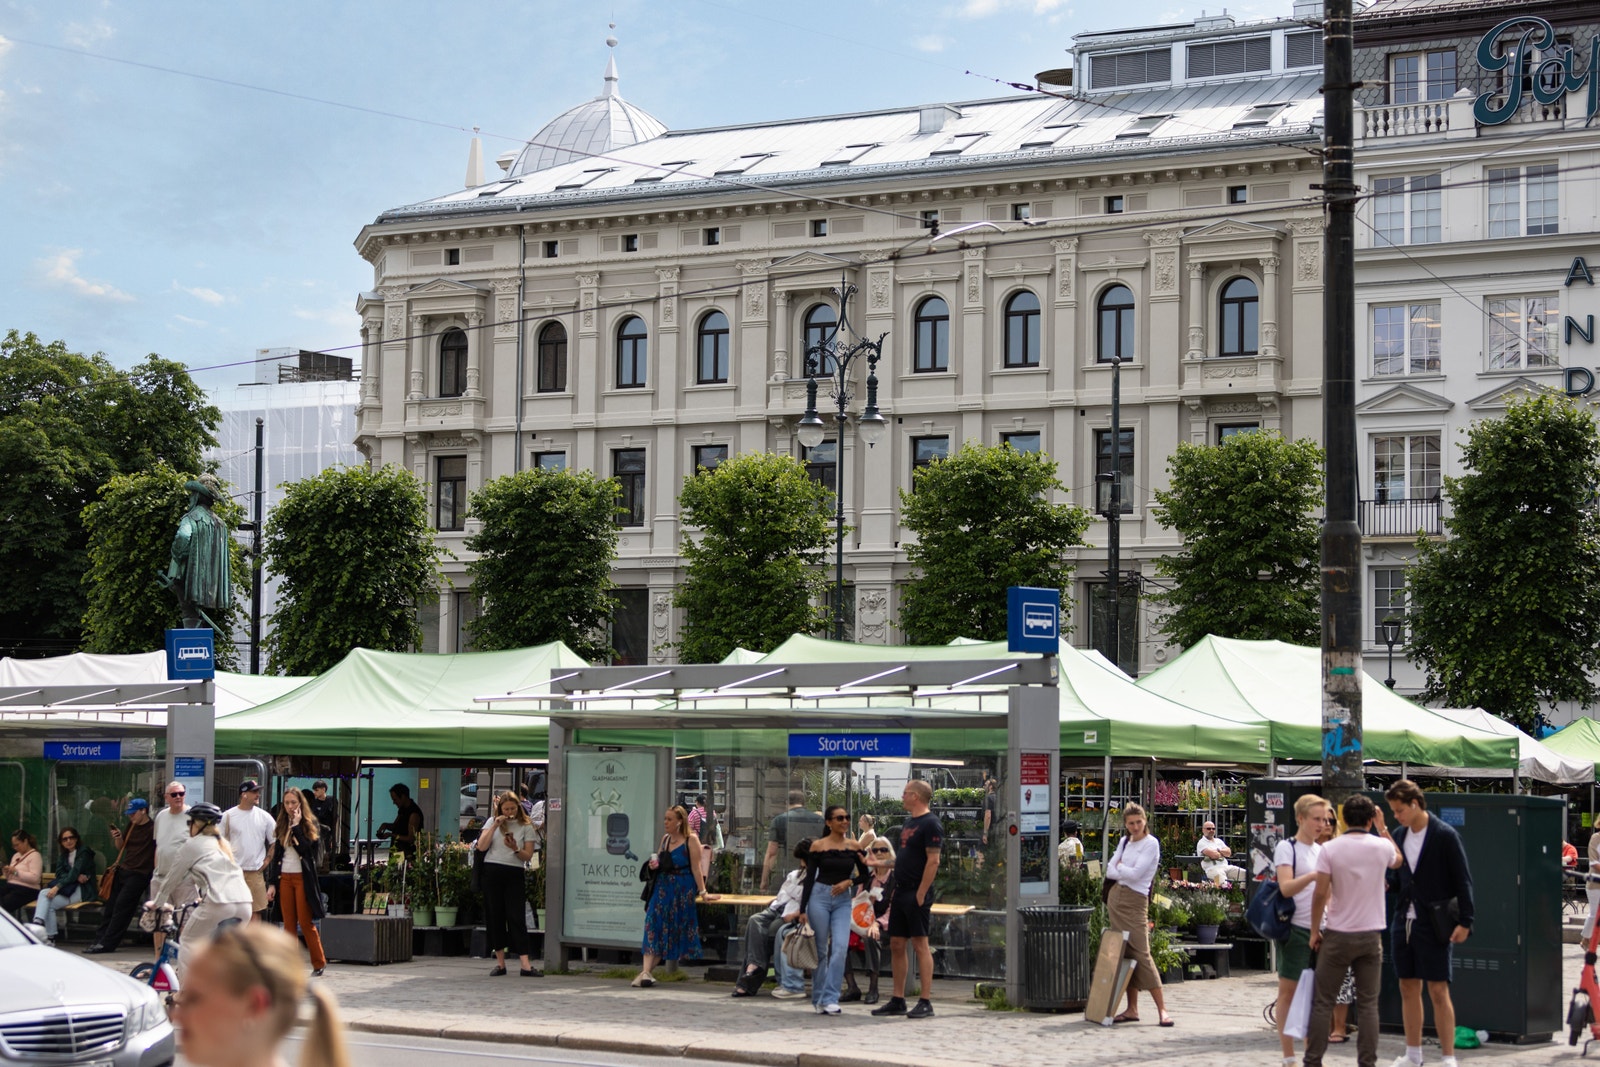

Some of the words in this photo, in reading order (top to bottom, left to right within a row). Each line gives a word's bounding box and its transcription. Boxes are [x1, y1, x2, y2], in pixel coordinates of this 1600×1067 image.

[62, 743, 101, 756] Stortorvet
[818, 736, 879, 751] Stortorvet
[581, 863, 610, 877] TAKK
[613, 864, 637, 879] FOR
